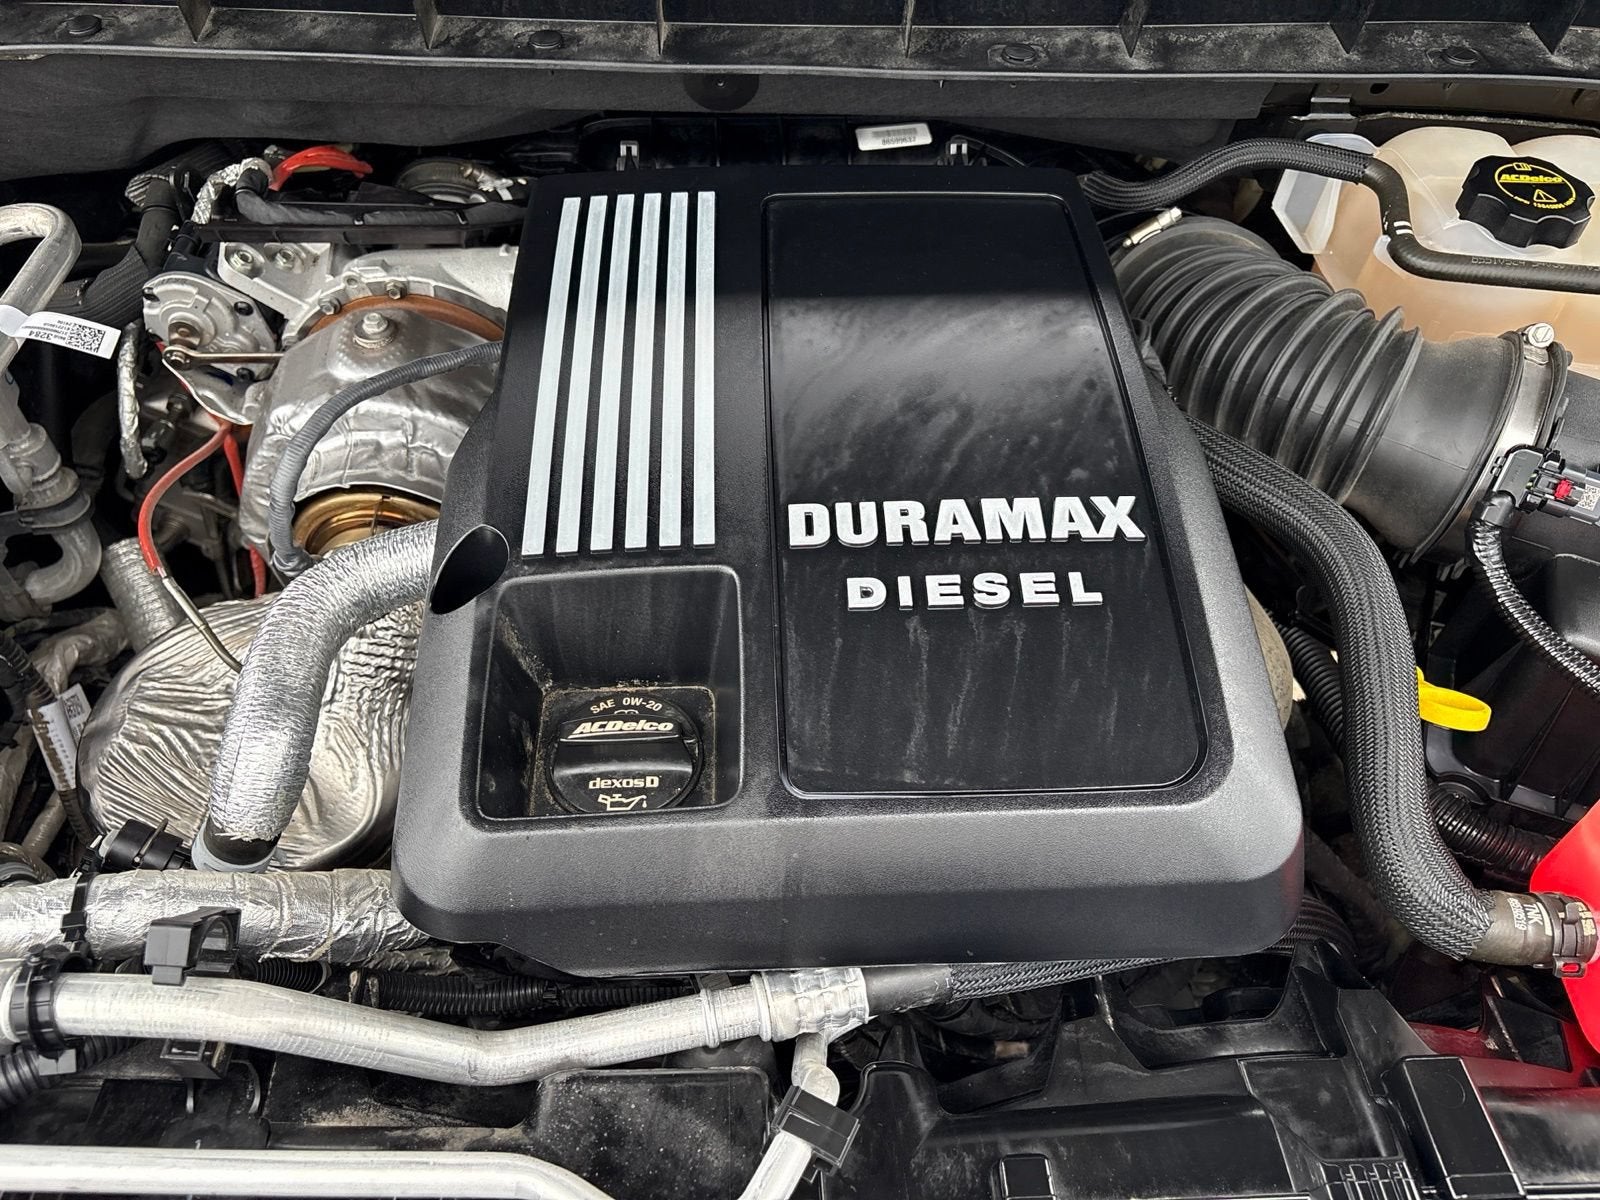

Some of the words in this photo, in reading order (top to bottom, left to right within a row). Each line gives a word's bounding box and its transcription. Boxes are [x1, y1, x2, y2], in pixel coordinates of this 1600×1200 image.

[1499, 173, 1564, 183] ACDelco
[28, 330, 53, 341] 3284
[787, 495, 1146, 549] DURAMAX
[846, 571, 1104, 611] DIESEL
[590, 698, 616, 714] SAE
[622, 697, 663, 712] 0W-20
[571, 719, 674, 735] ACDelco
[588, 775, 660, 789] dexosD
[1523, 903, 1544, 926] TNK
